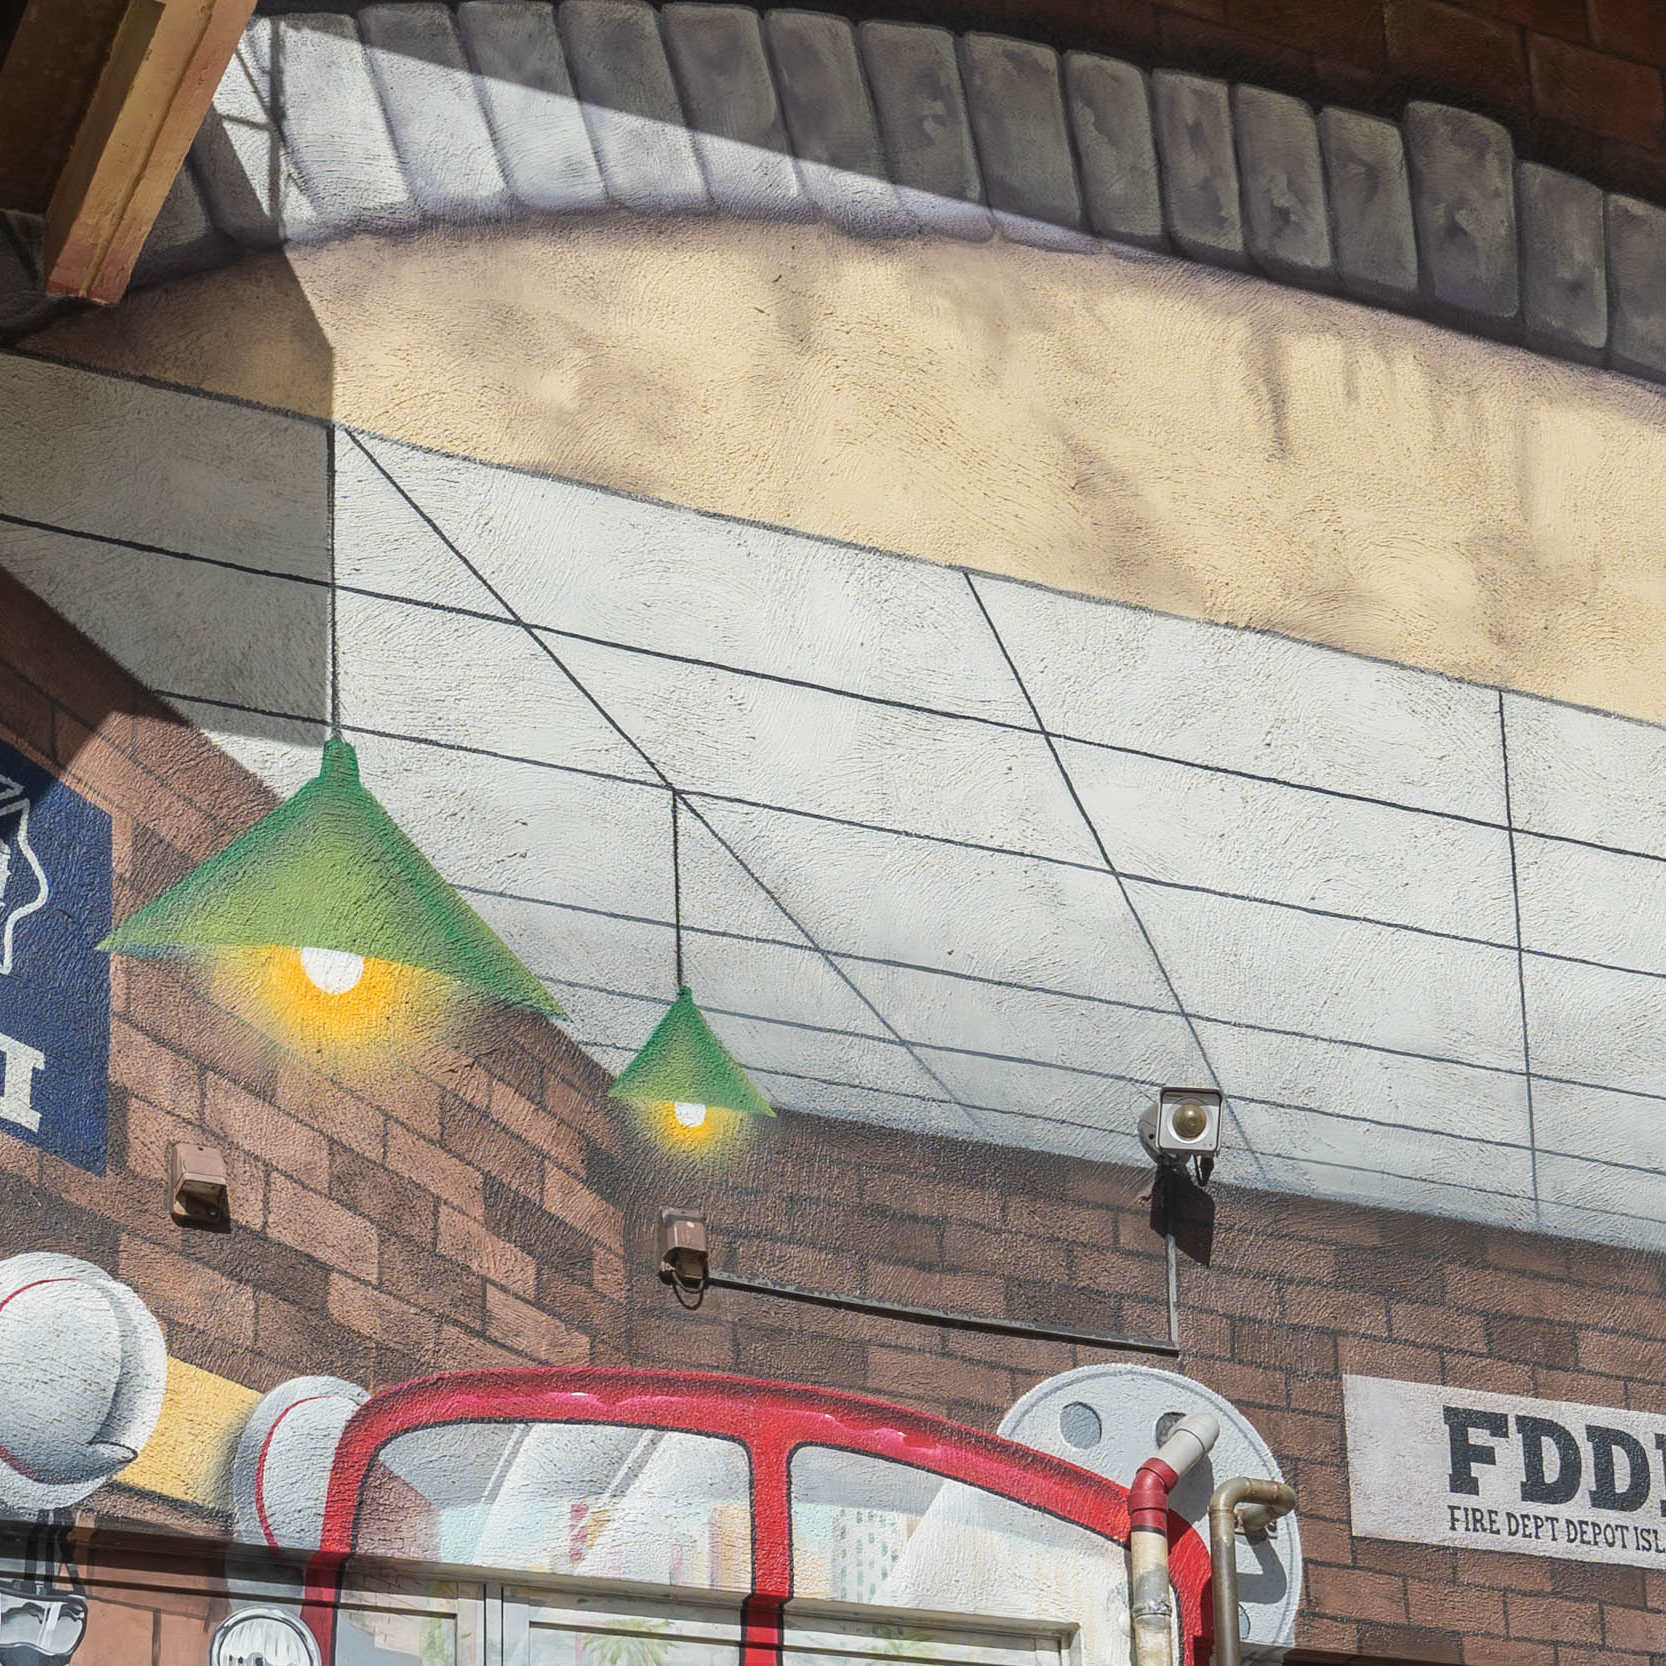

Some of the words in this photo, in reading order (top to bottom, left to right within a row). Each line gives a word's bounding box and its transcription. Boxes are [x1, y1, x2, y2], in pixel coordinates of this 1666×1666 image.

[1447, 1505, 1501, 1536] FIRE
[1506, 1511, 1560, 1542] DEPT
[1565, 1518, 1630, 1550] DEPOT
